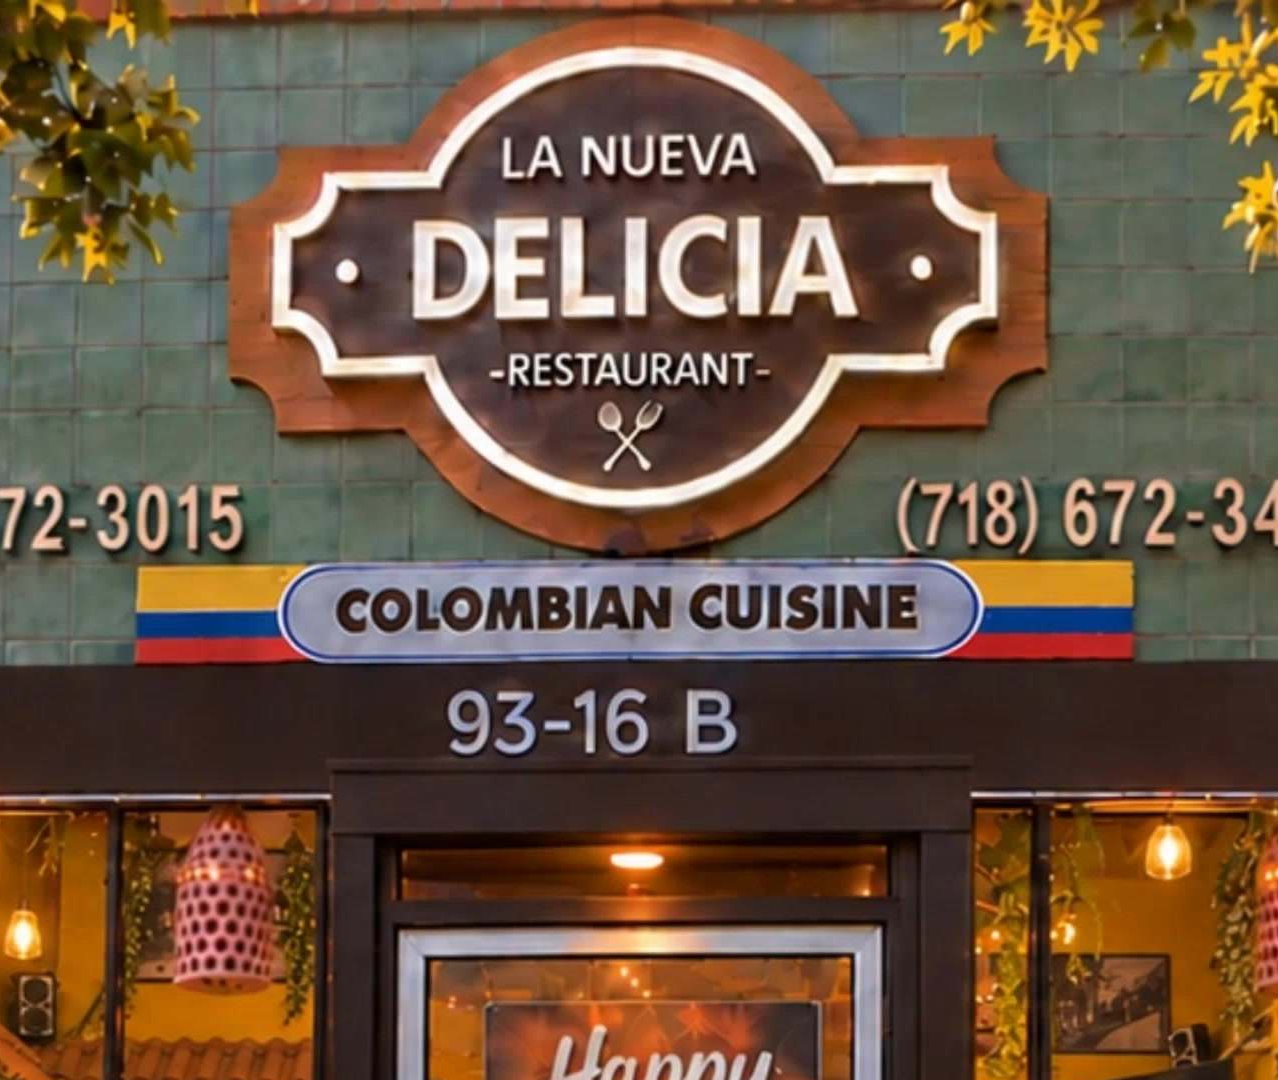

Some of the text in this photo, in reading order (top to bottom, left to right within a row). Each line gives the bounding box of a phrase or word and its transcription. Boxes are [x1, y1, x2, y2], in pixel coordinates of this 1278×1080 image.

[501, 132, 757, 181] LA NUEVA
[411, 215, 859, 321] DELICIA
[896, 476, 1039, 555] (718)
[333, 583, 920, 635] COLOMBIAN CUISINE
[446, 688, 739, 756] 93-16 B
